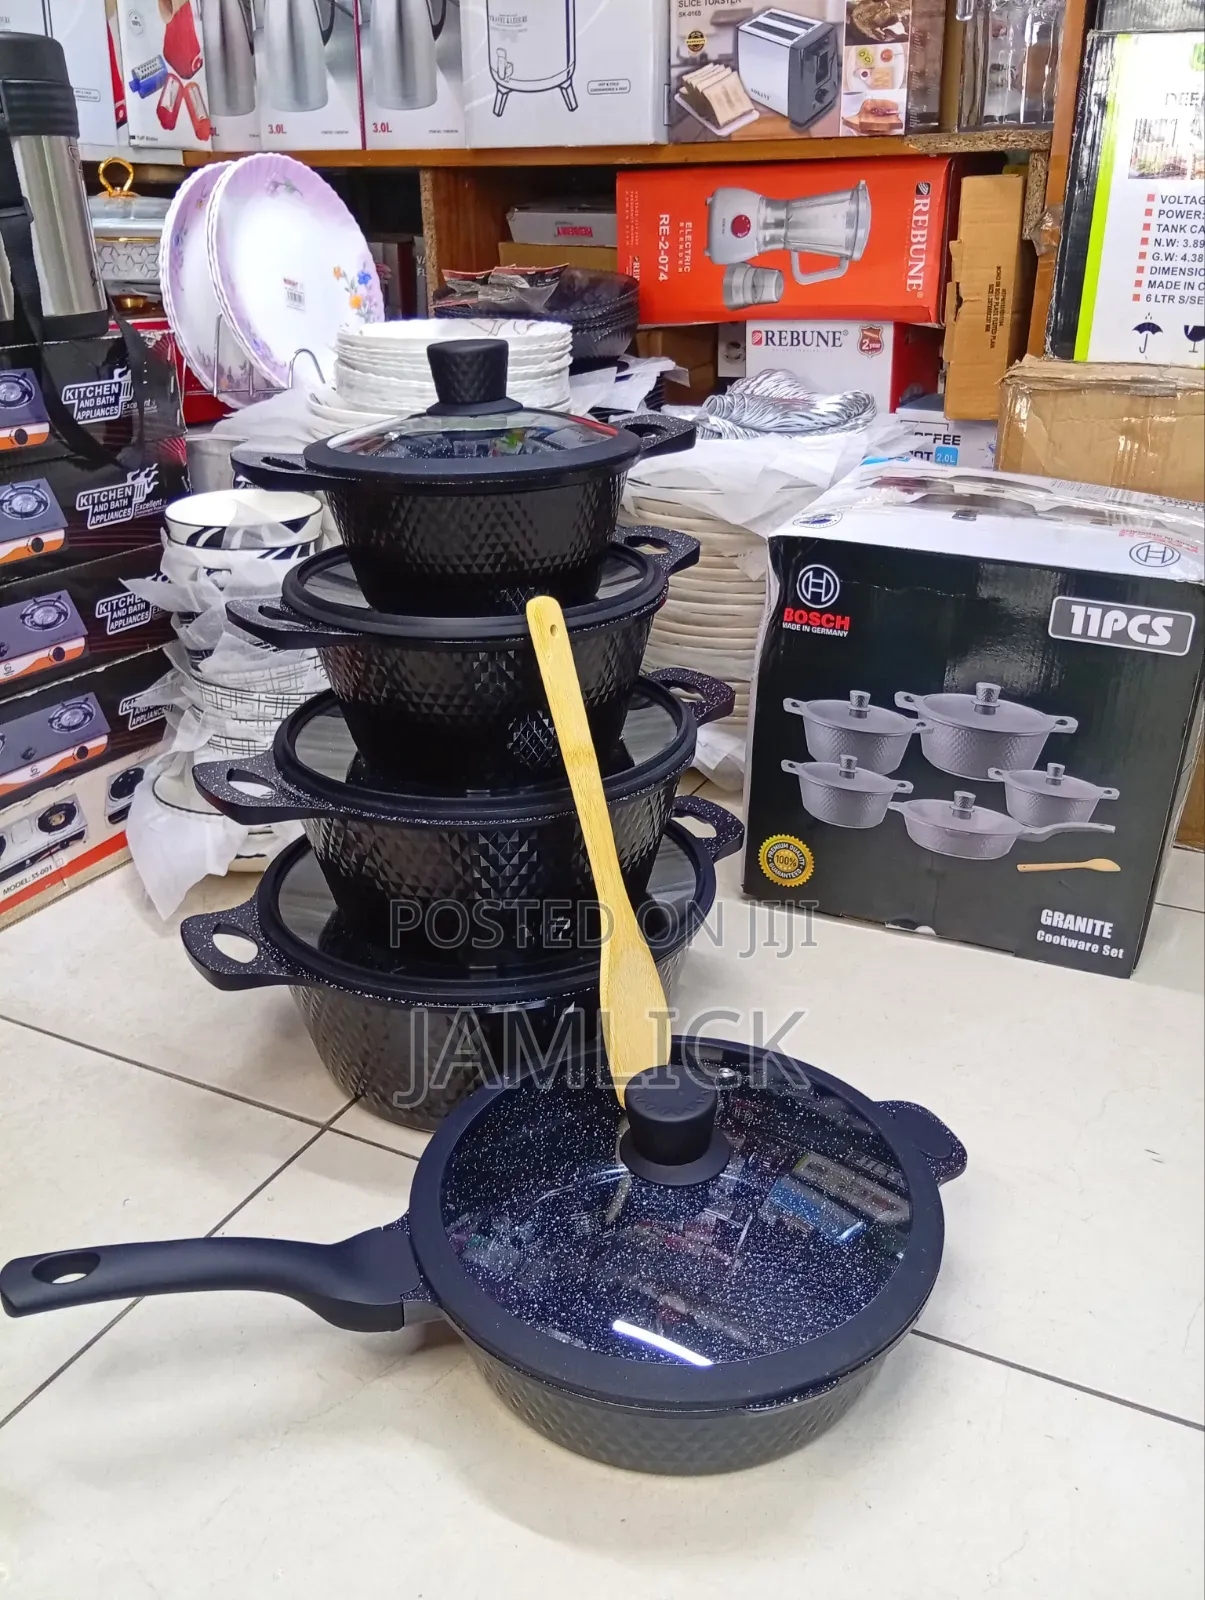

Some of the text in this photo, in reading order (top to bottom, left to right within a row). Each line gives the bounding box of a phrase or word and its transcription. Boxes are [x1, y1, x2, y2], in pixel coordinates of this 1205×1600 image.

[268, 124, 288, 135] 3.0L
[372, 123, 393, 134] 3.0L
[1156, 223, 1187, 234] TANK
[658, 213, 671, 283] RE-2-074
[677, 221, 686, 274] BLENDER
[683, 221, 694, 274] ELECTRIC
[905, 197, 932, 293] REBUNE
[1153, 237, 1180, 248] N.W:
[1151, 251, 1204, 263] G.W: 4.38
[1147, 280, 1181, 290] MADE
[1183, 281, 1195, 291] IN
[1145, 293, 1152, 303] 6
[1154, 294, 1176, 304] LTR
[763, 330, 843, 348] REBUNE
[861, 339, 870, 350] 2
[65, 383, 119, 401] KITCHEN
[79, 395, 115, 409] AND BATH
[76, 406, 119, 420] APPLIANCES
[936, 453, 956, 464] 2.0L
[79, 485, 133, 507] KITCHEN
[93, 498, 129, 514] AND BATH
[134, 498, 163, 513] Excellent
[90, 507, 132, 525] APPLIANCES
[100, 593, 142, 615] KITCH
[112, 608, 127, 620] AND
[128, 602, 146, 613] BATH
[109, 610, 150, 631] APPLIANCES
[783, 607, 851, 631] BOSCH
[1070, 604, 1174, 646] 11PCS
[782, 621, 849, 638] MADE IN GERMANY
[768, 843, 805, 866] PREMIUM QUALITY
[775, 854, 797, 867] 100%
[768, 862, 802, 879] GUARANTEED
[1040, 908, 1113, 939] GRANITE
[1036, 930, 1124, 959] Cookware Set
